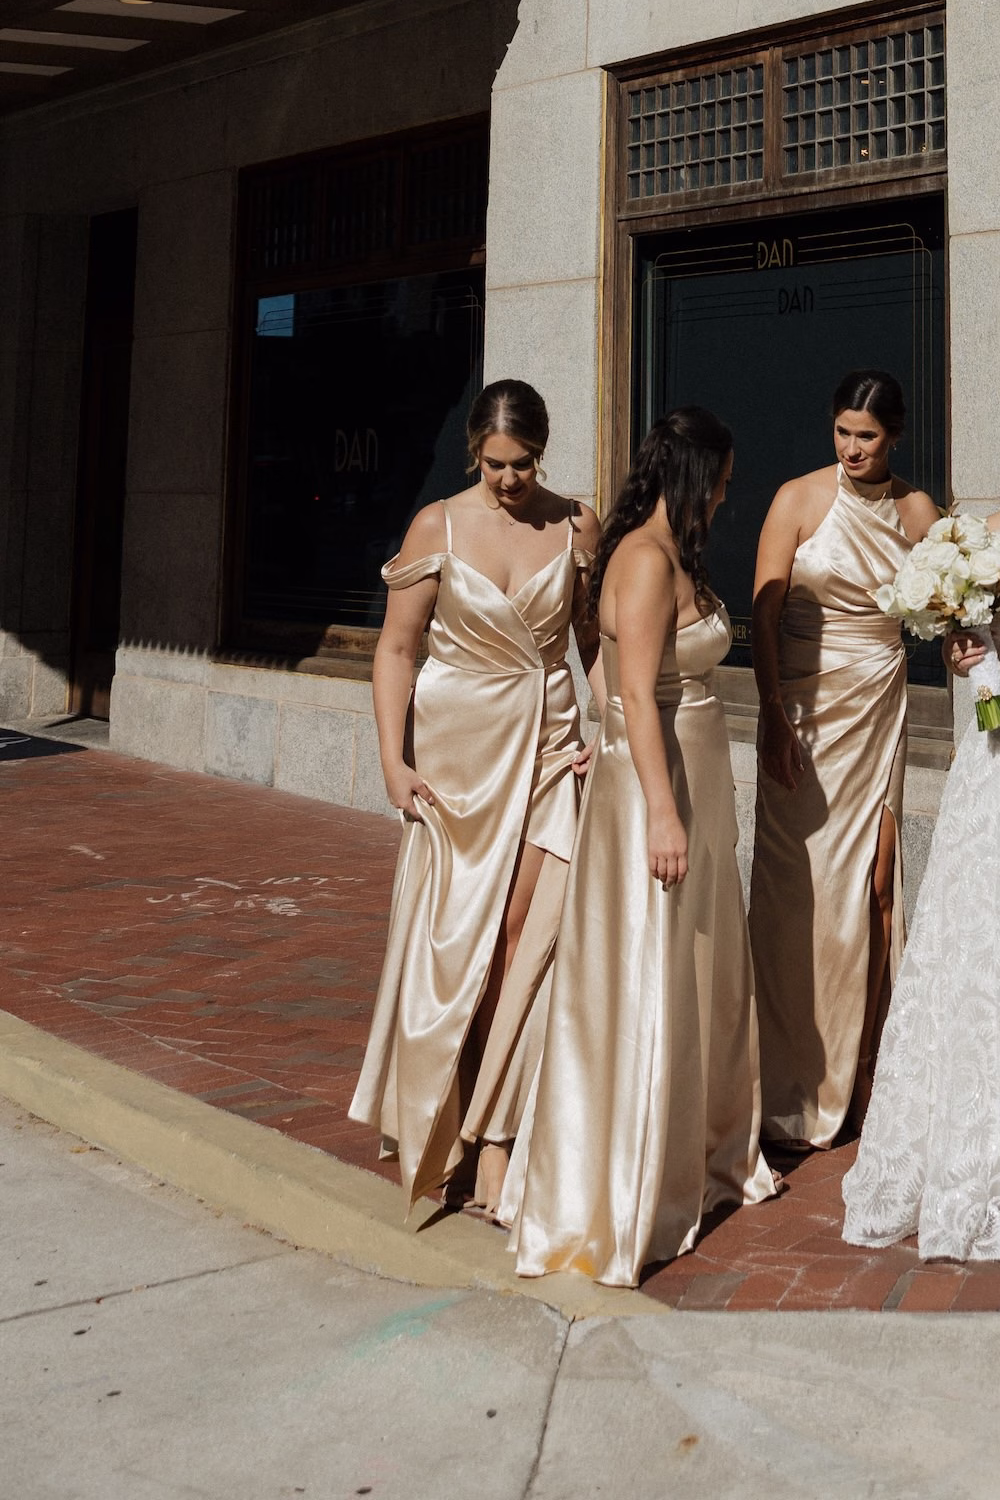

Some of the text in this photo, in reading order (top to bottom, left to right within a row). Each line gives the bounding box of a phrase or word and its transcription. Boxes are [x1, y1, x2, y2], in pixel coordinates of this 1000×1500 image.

[757, 238, 794, 269] DAN
[778, 285, 814, 315] DAN
[334, 427, 379, 473] DAN
